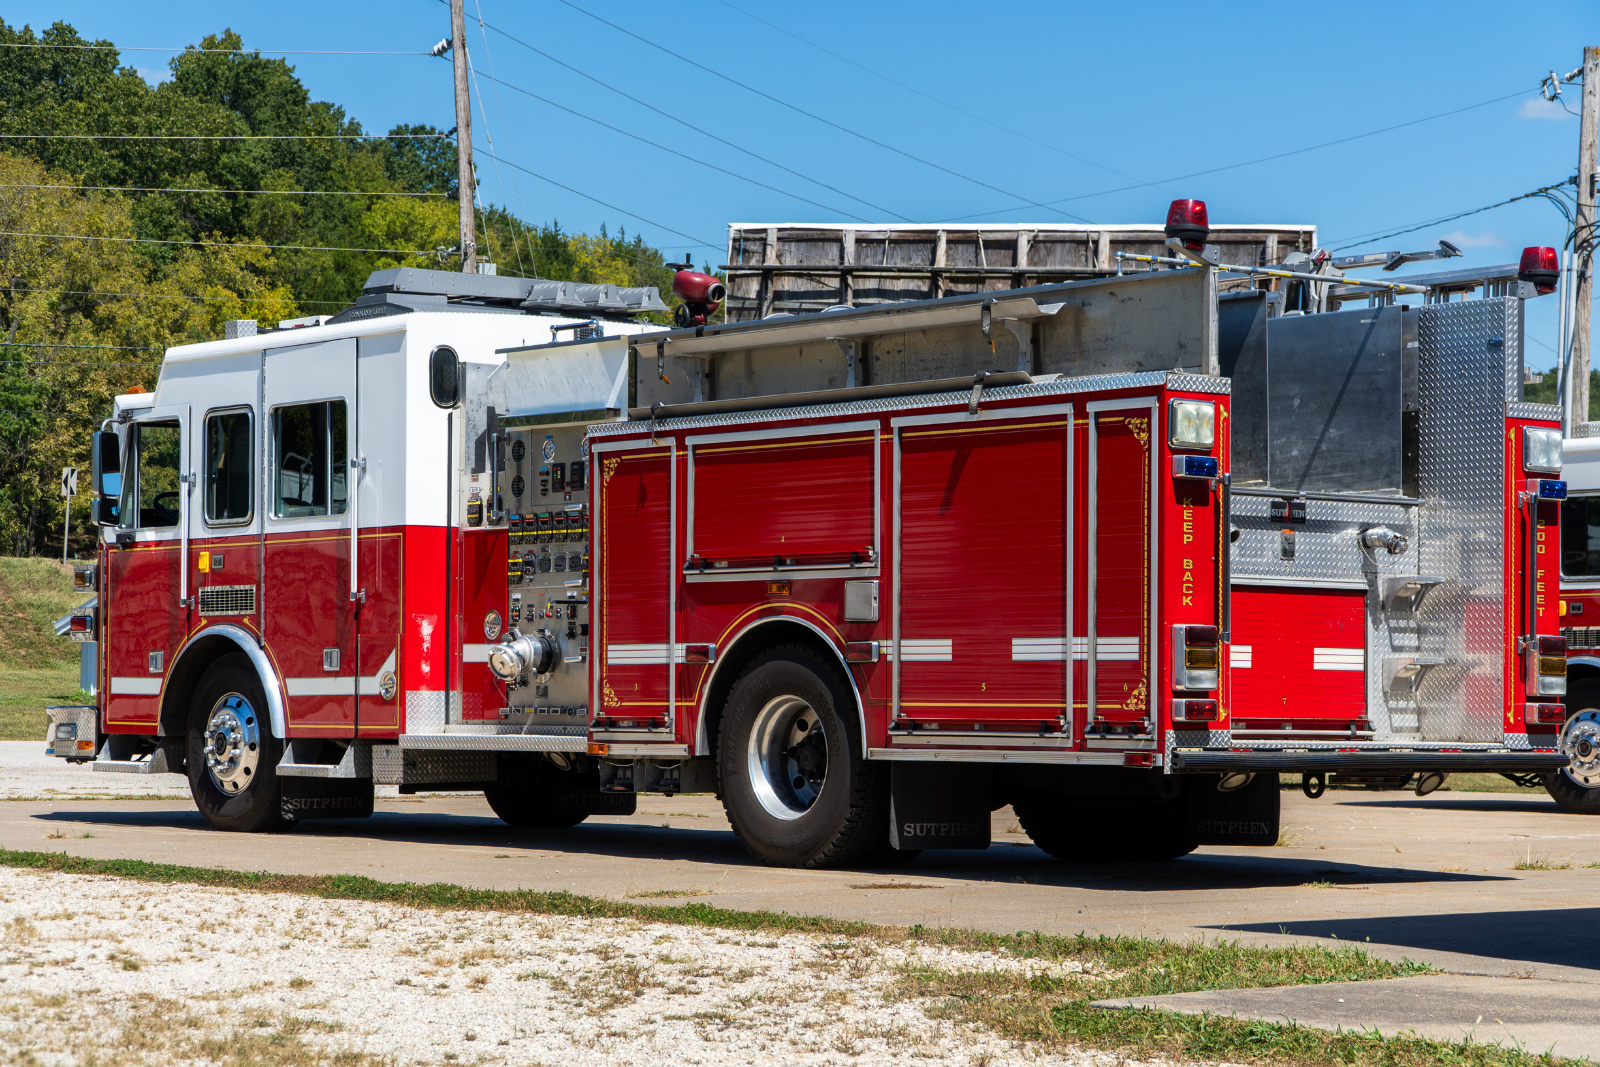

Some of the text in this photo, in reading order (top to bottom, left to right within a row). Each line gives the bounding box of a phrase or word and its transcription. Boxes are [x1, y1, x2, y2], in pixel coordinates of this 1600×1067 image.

[1182, 497, 1194, 606] KEEP BACK
[1536, 519, 1546, 617] 200 FEET
[291, 797, 364, 809] SUTPHEN
[903, 823, 982, 837] SUTPHEN
[1197, 820, 1271, 835] SUTPHEN
